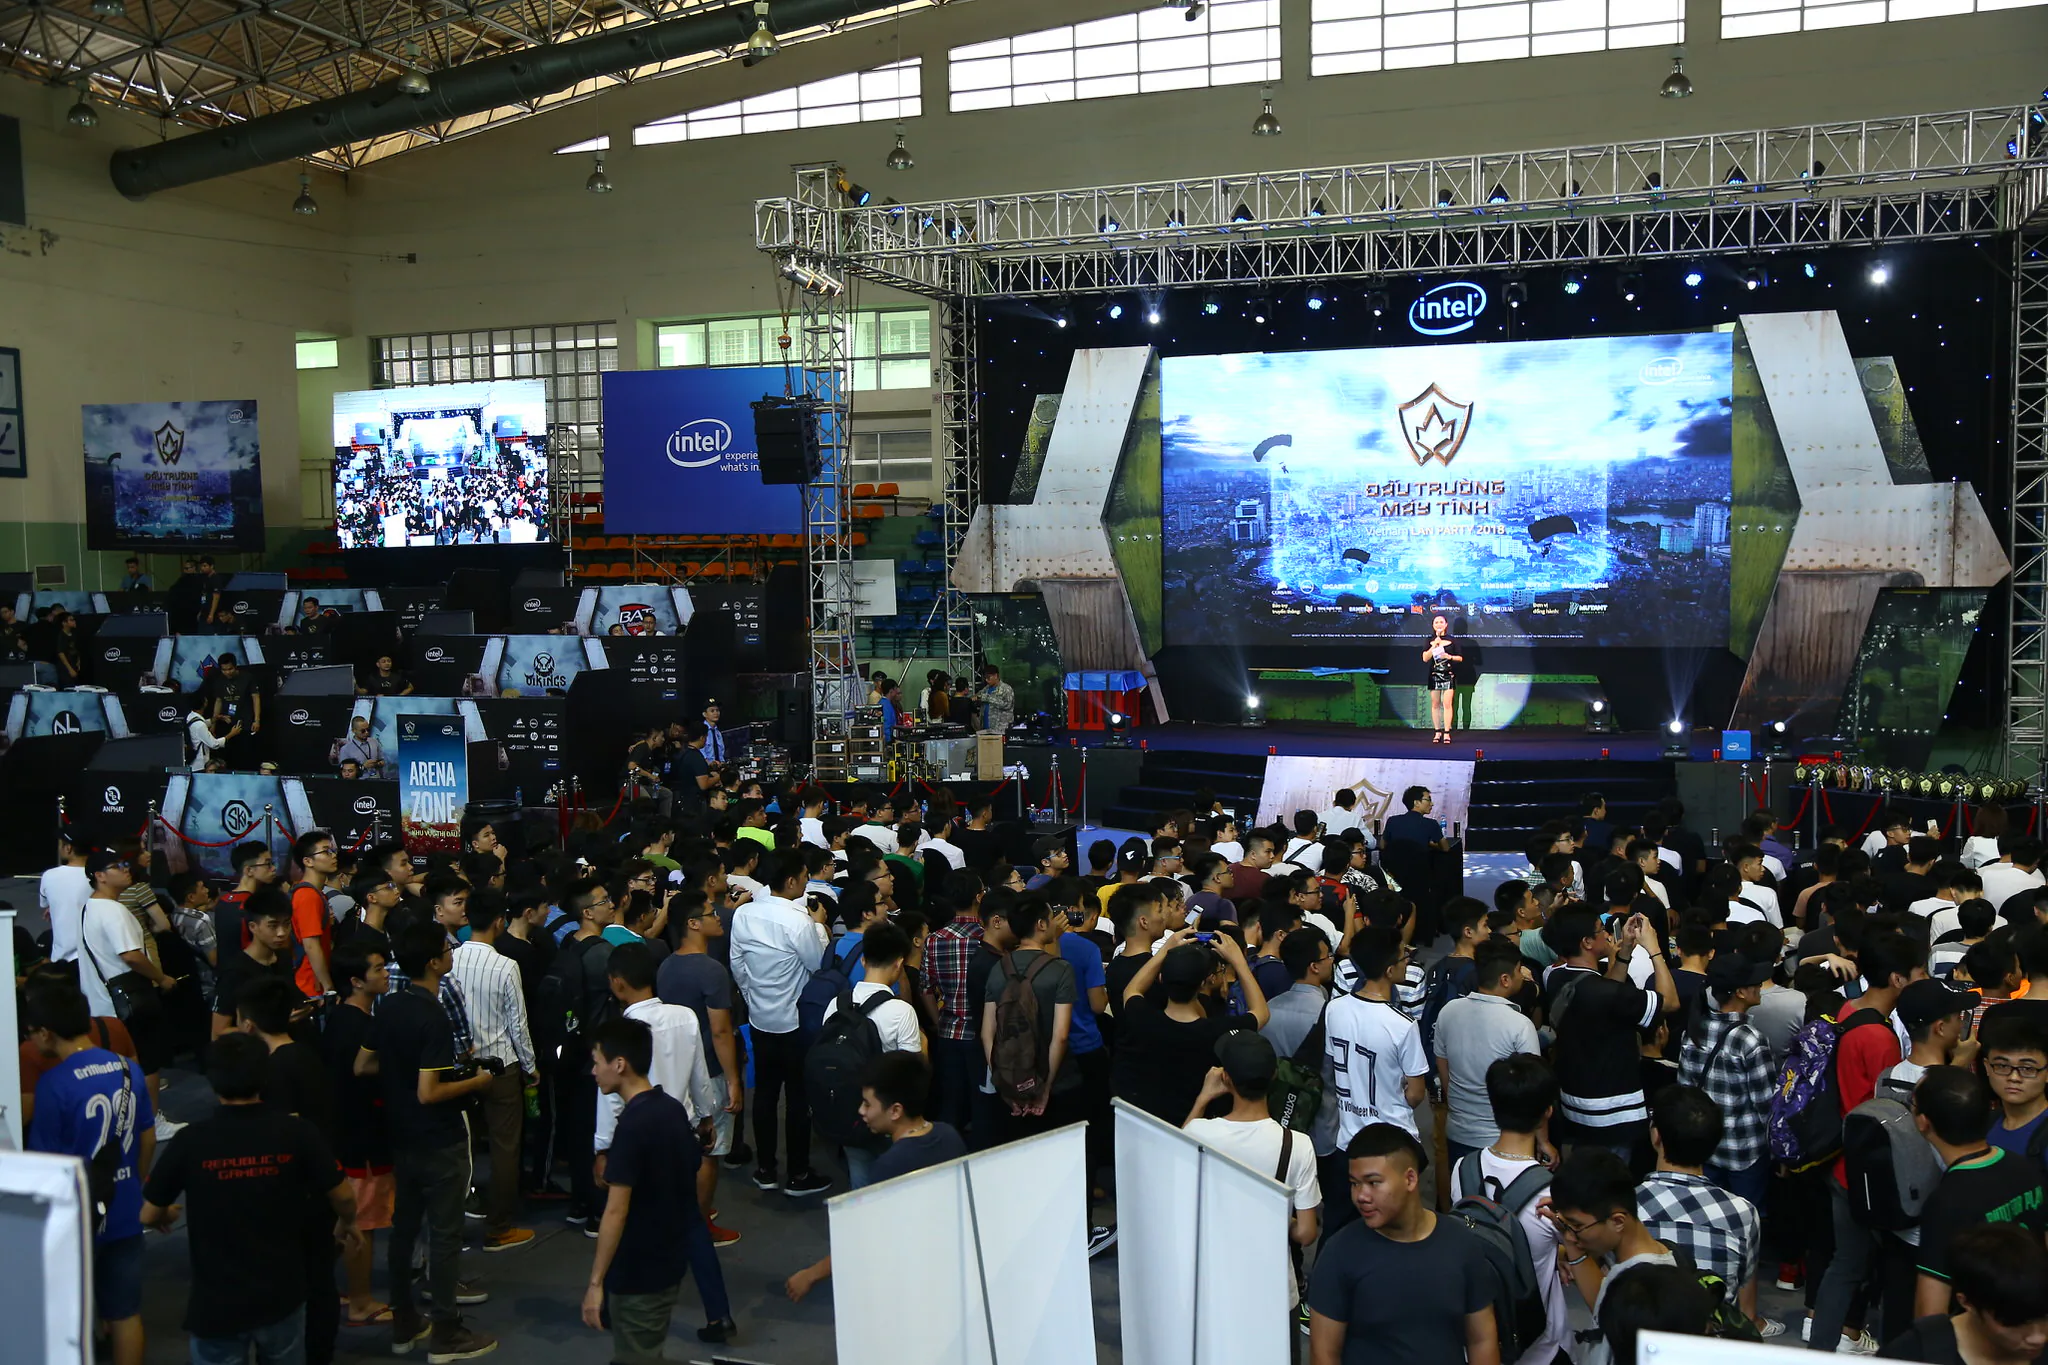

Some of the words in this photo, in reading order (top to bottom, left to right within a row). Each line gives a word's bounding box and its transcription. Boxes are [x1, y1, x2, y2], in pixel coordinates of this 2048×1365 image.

[1419, 293, 1473, 319] intel
[675, 429, 720, 451] intel
[725, 450, 759, 462] experie
[720, 462, 749, 472] what's
[751, 462, 761, 472] in
[1381, 499, 1431, 516] MÁY
[1436, 498, 1489, 515] TÍNH
[1366, 526, 1409, 537] Vietnam
[1411, 526, 1435, 536] LAN
[1438, 525, 1475, 536] PARTY
[1476, 524, 1507, 535] 2018
[1589, 582, 1609, 590] Digital
[409, 760, 457, 787] ARENA
[101, 805, 125, 814] ANPHAT
[410, 790, 457, 823] ZONE
[73, 1061, 125, 1081] Griffindo
[1330, 1036, 1377, 1107] 27
[1281, 1092, 1297, 1129] EXTRAB
[202, 1154, 274, 1169] REPUBLIC
[276, 1153, 293, 1164] OF
[217, 1166, 280, 1180] GAMERS
